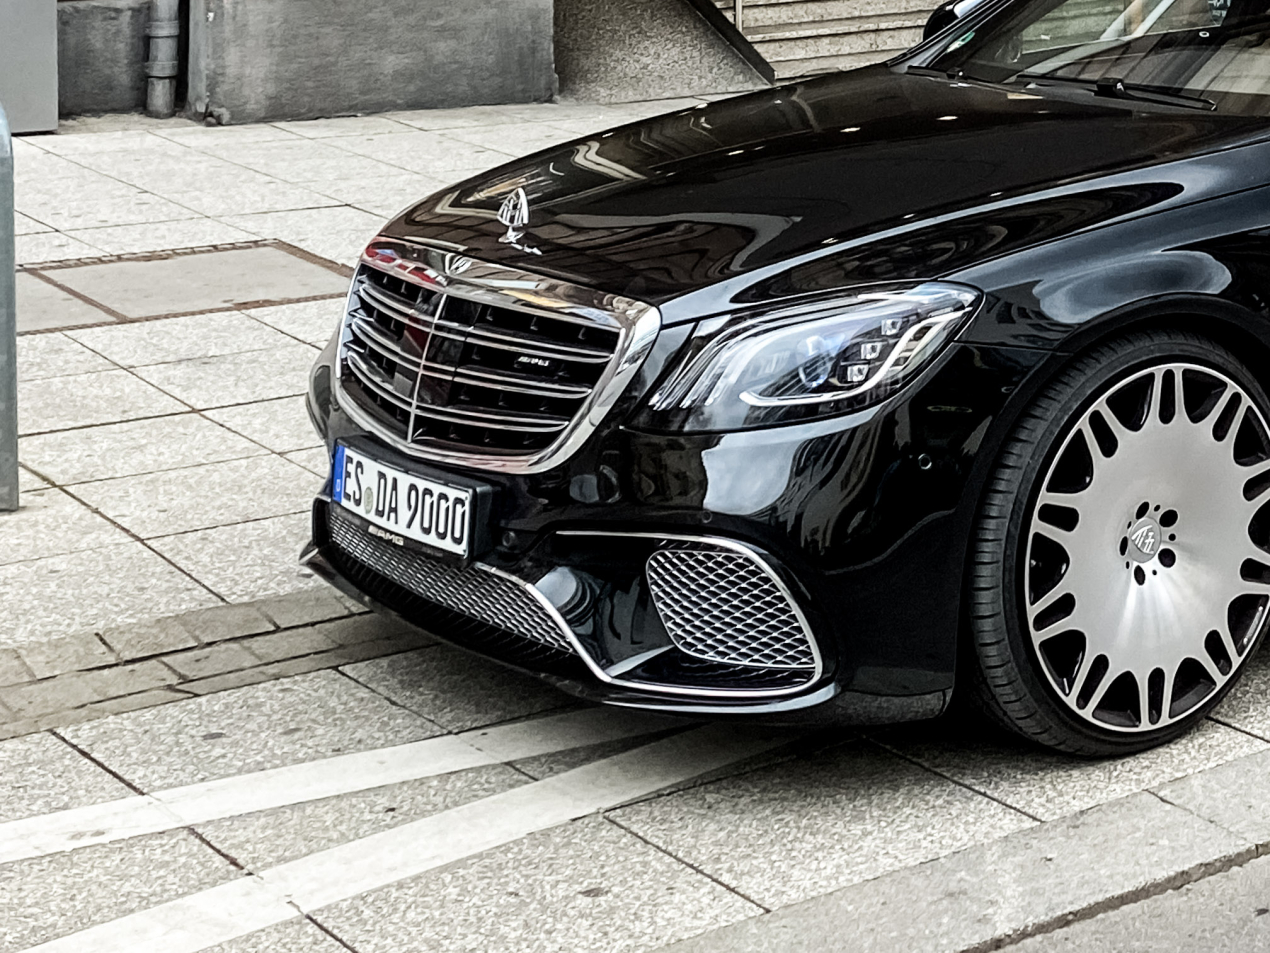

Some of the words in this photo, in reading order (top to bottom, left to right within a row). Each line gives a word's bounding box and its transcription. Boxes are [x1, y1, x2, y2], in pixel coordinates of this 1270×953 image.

[343, 454, 364, 507] ES
[375, 470, 399, 525] DA
[406, 483, 466, 546] 9000
[377, 529, 404, 546] AMG
